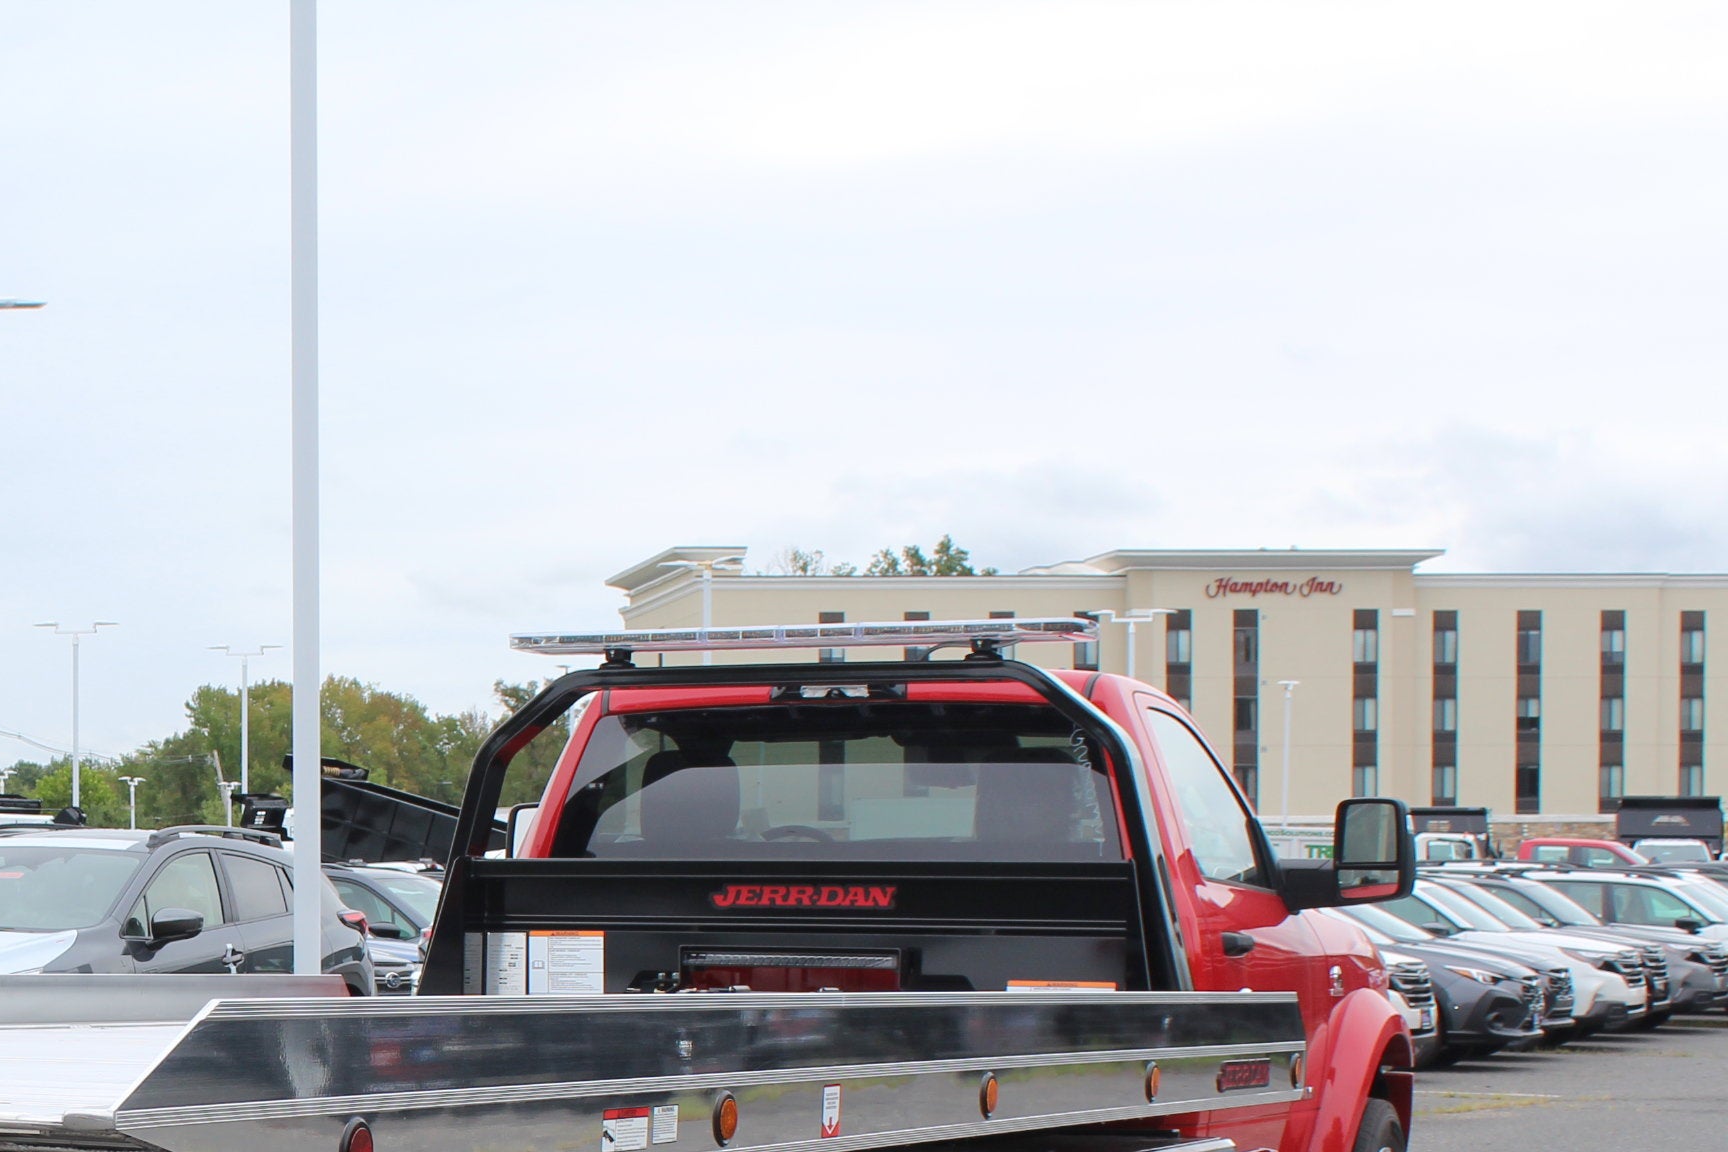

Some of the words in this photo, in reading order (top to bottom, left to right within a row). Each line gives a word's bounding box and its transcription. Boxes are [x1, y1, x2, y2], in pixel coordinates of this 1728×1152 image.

[1205, 576, 1297, 598] Hampton
[1299, 576, 1342, 598] Inn
[712, 885, 897, 907] JERR-DAN
